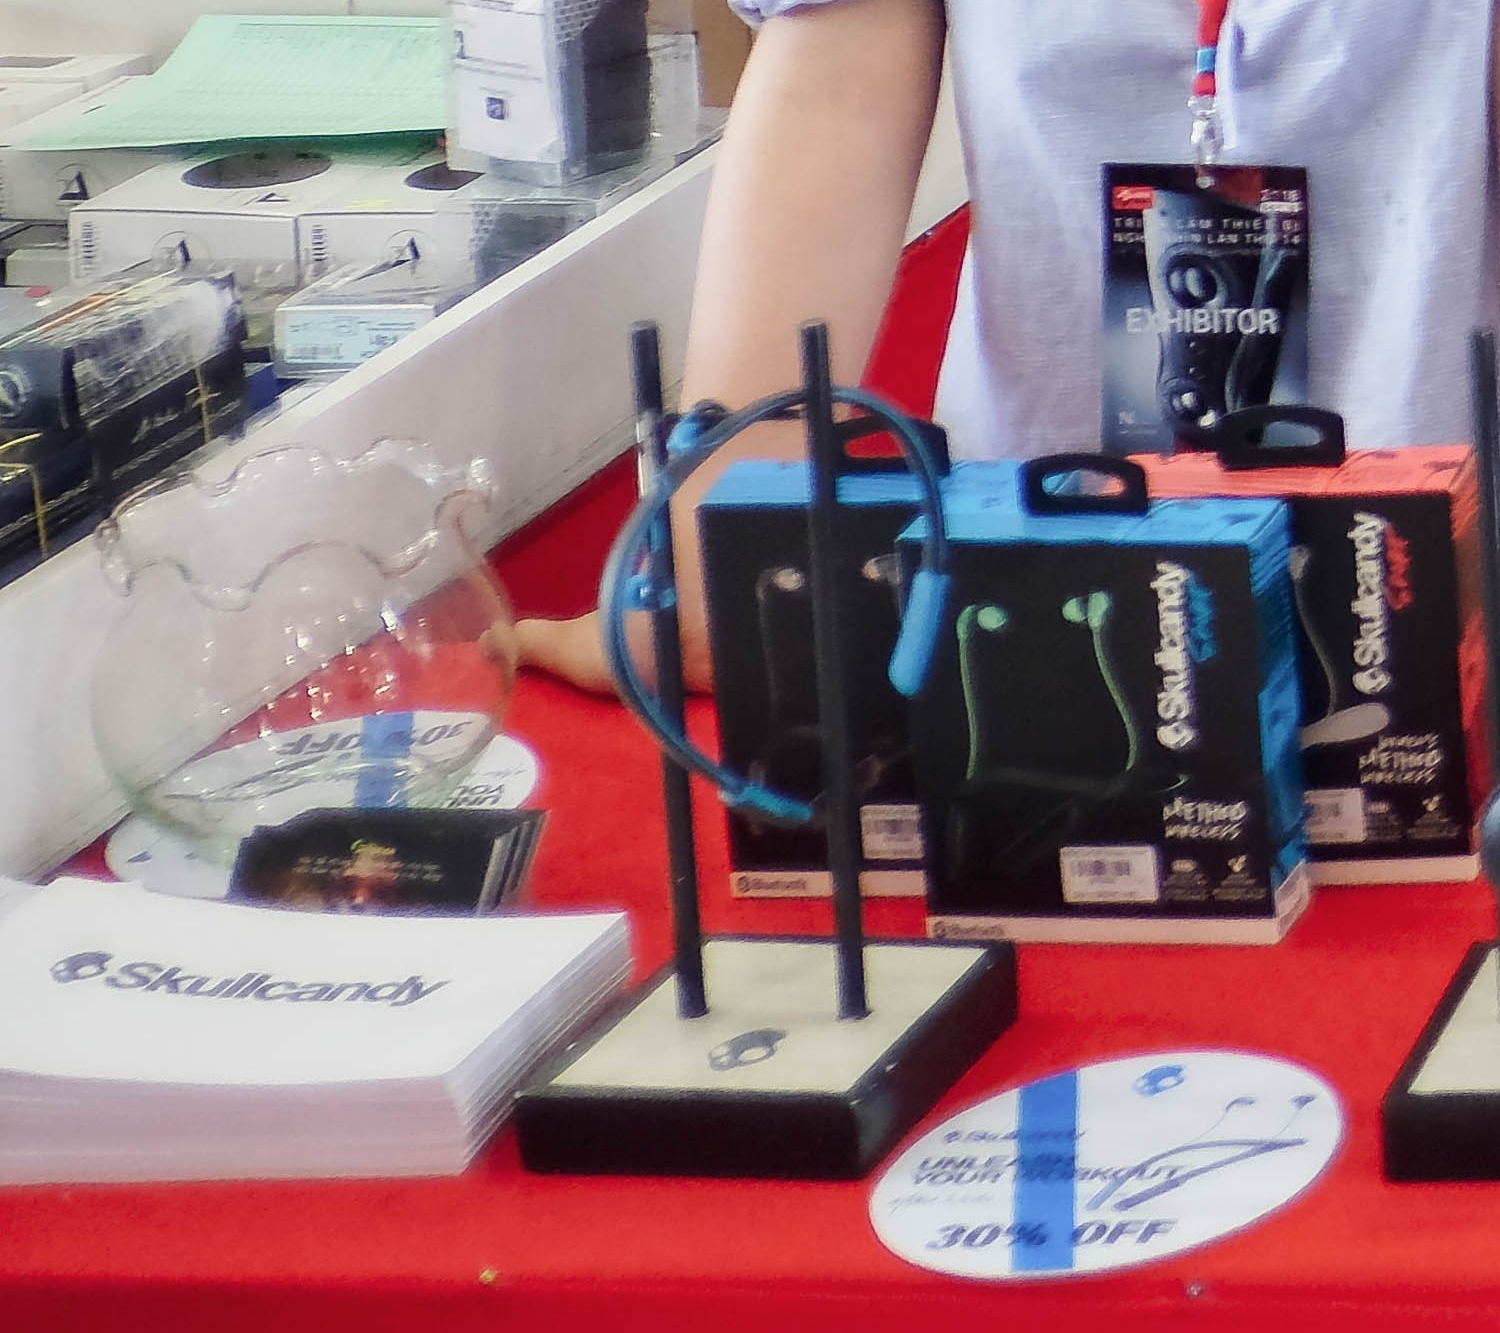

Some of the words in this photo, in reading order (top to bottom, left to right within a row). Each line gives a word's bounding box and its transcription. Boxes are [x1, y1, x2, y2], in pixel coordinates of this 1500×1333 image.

[1126, 306, 1281, 334] EXHIBITOR
[1347, 511, 1388, 666] Skullcandy
[1150, 560, 1191, 721] Skullcandy
[103, 960, 453, 1008] Skullcandy
[925, 1220, 1049, 1250] 30%
[1070, 1218, 1179, 1247] OFF
